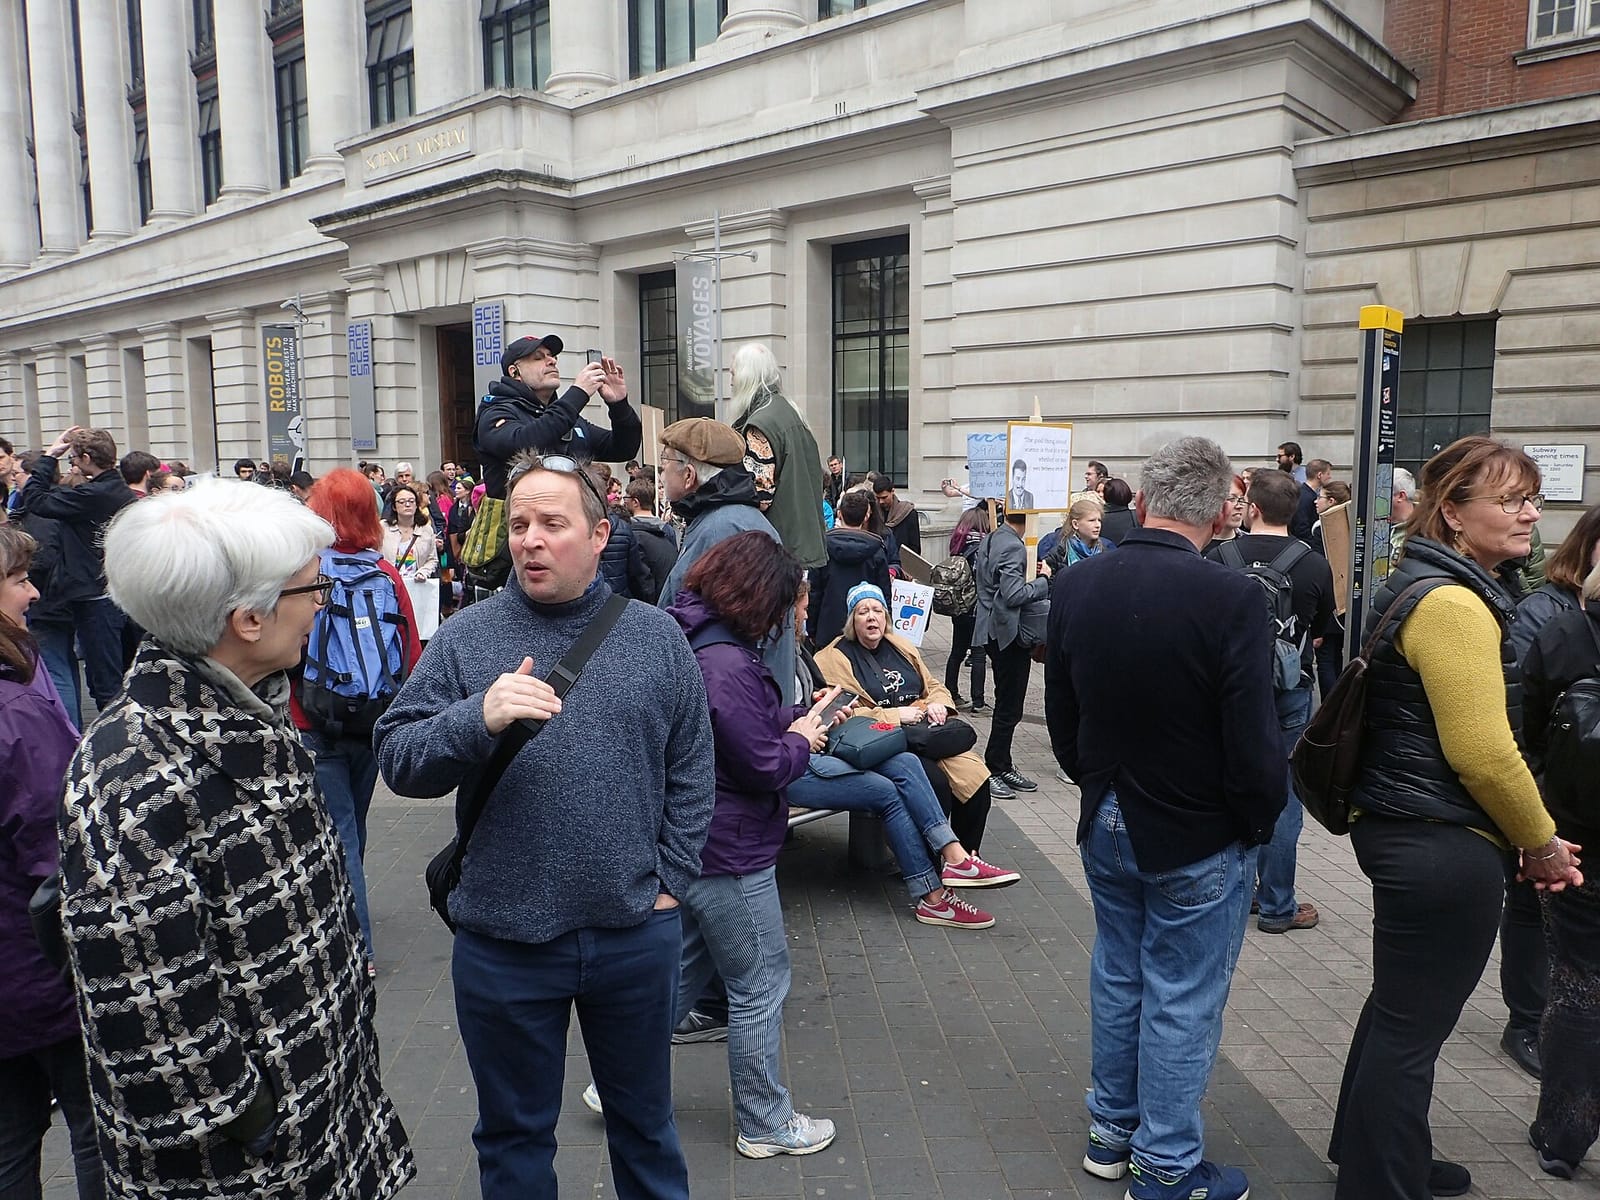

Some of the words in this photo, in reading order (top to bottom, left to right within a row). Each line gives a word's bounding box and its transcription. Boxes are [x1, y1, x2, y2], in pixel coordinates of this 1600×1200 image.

[366, 144, 409, 169] SCIENCE
[416, 126, 465, 155] MUSEUM
[283, 337, 289, 345] TO
[693, 276, 710, 371] VOYAGES
[266, 336, 285, 412] ROBOTS
